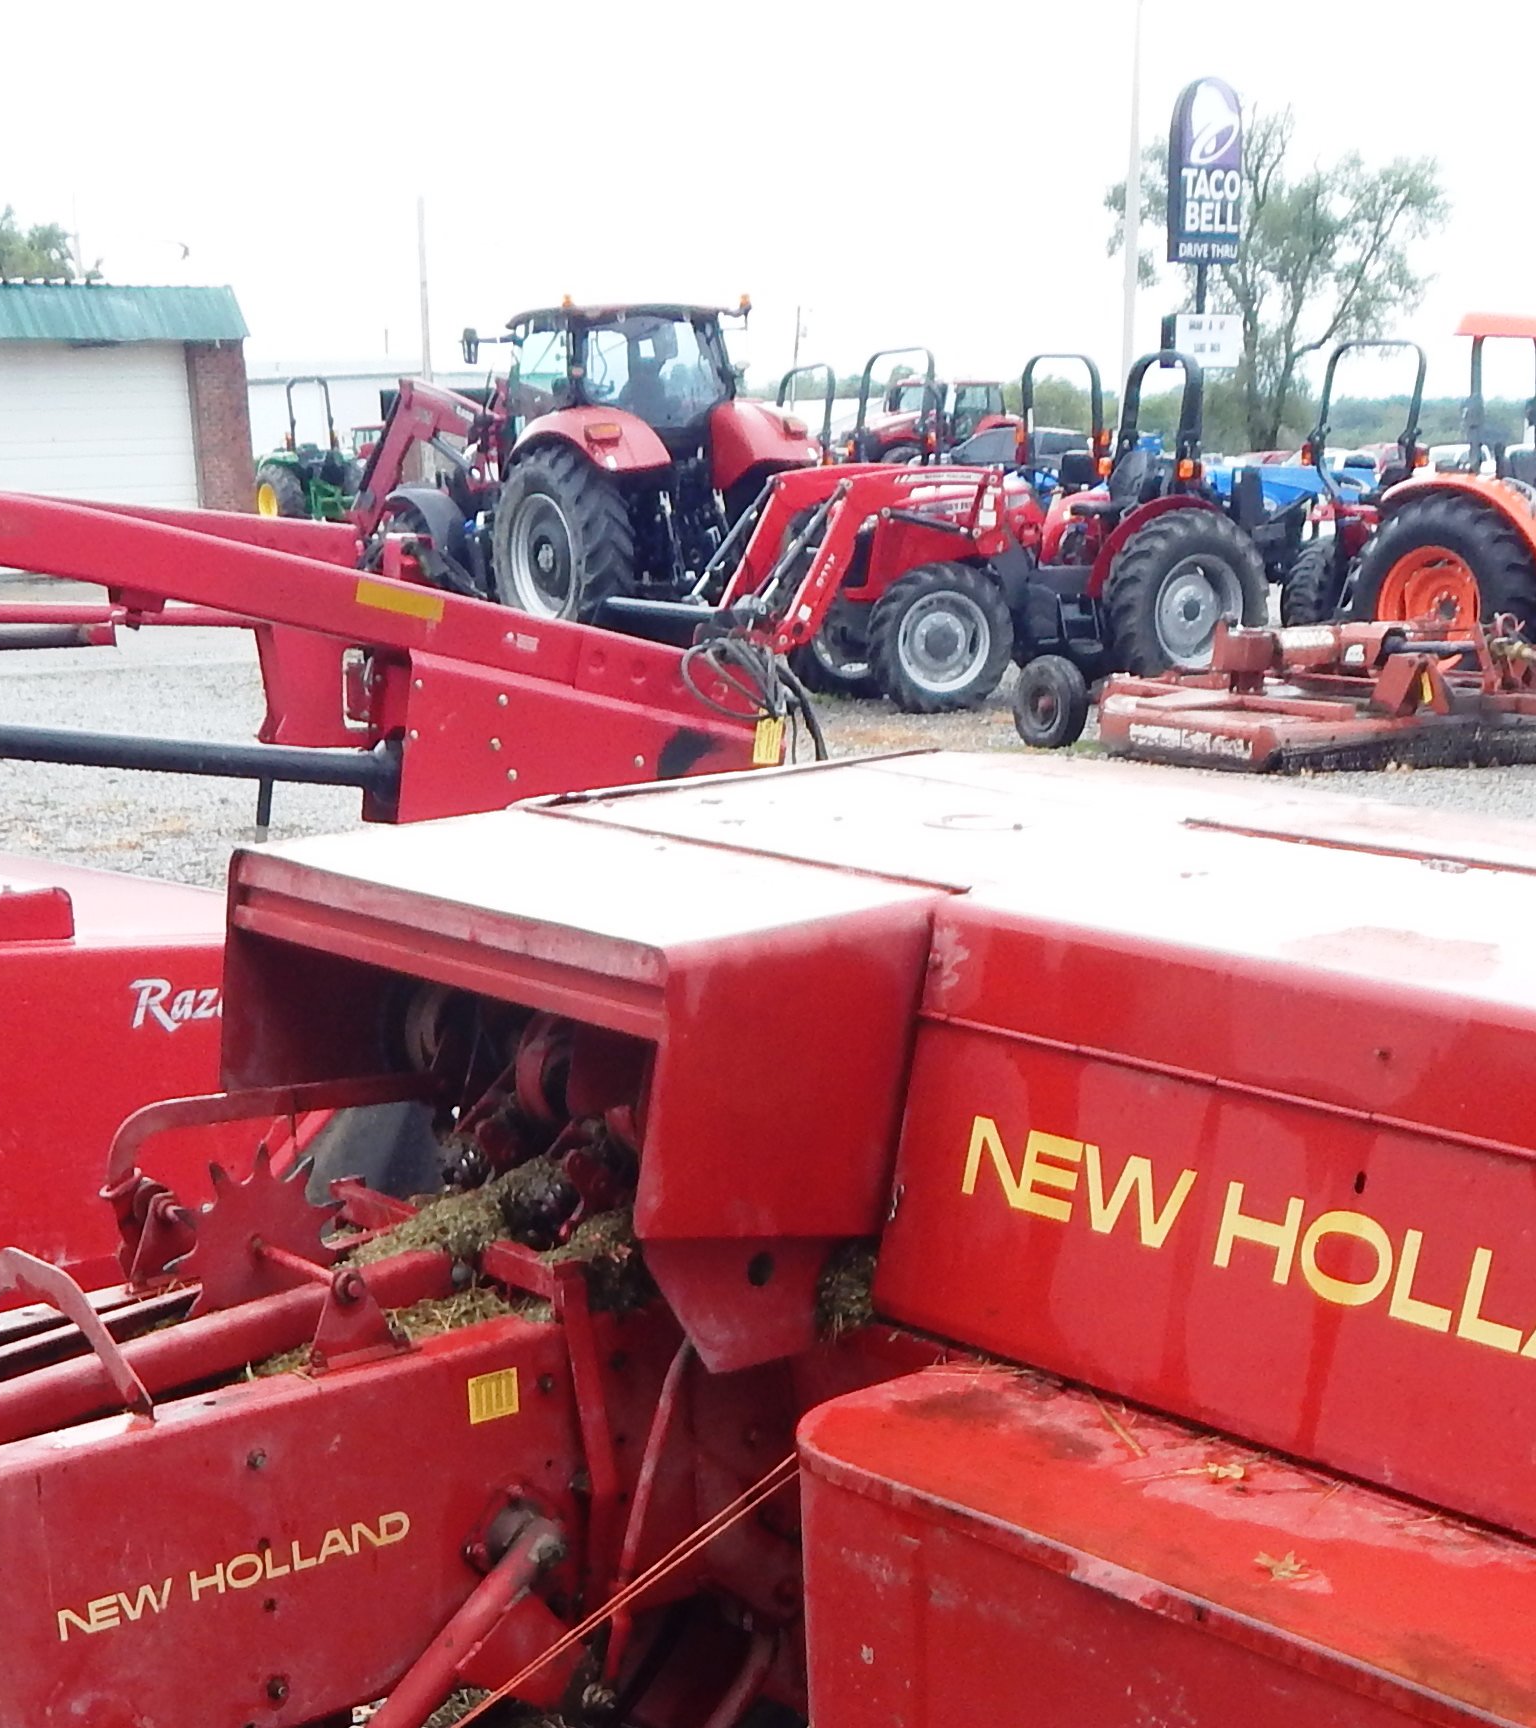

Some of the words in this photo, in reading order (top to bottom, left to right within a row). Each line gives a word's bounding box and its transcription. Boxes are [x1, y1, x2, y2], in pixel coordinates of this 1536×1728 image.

[1181, 168, 1240, 201] TACO
[1185, 201, 1238, 232] BELL
[1178, 242, 1209, 258] DRIVE
[1211, 243, 1238, 258] THRU
[961, 1114, 1198, 1250] NEW
[57, 1578, 172, 1642] NEW
[189, 1511, 411, 1602] HOLLAND
